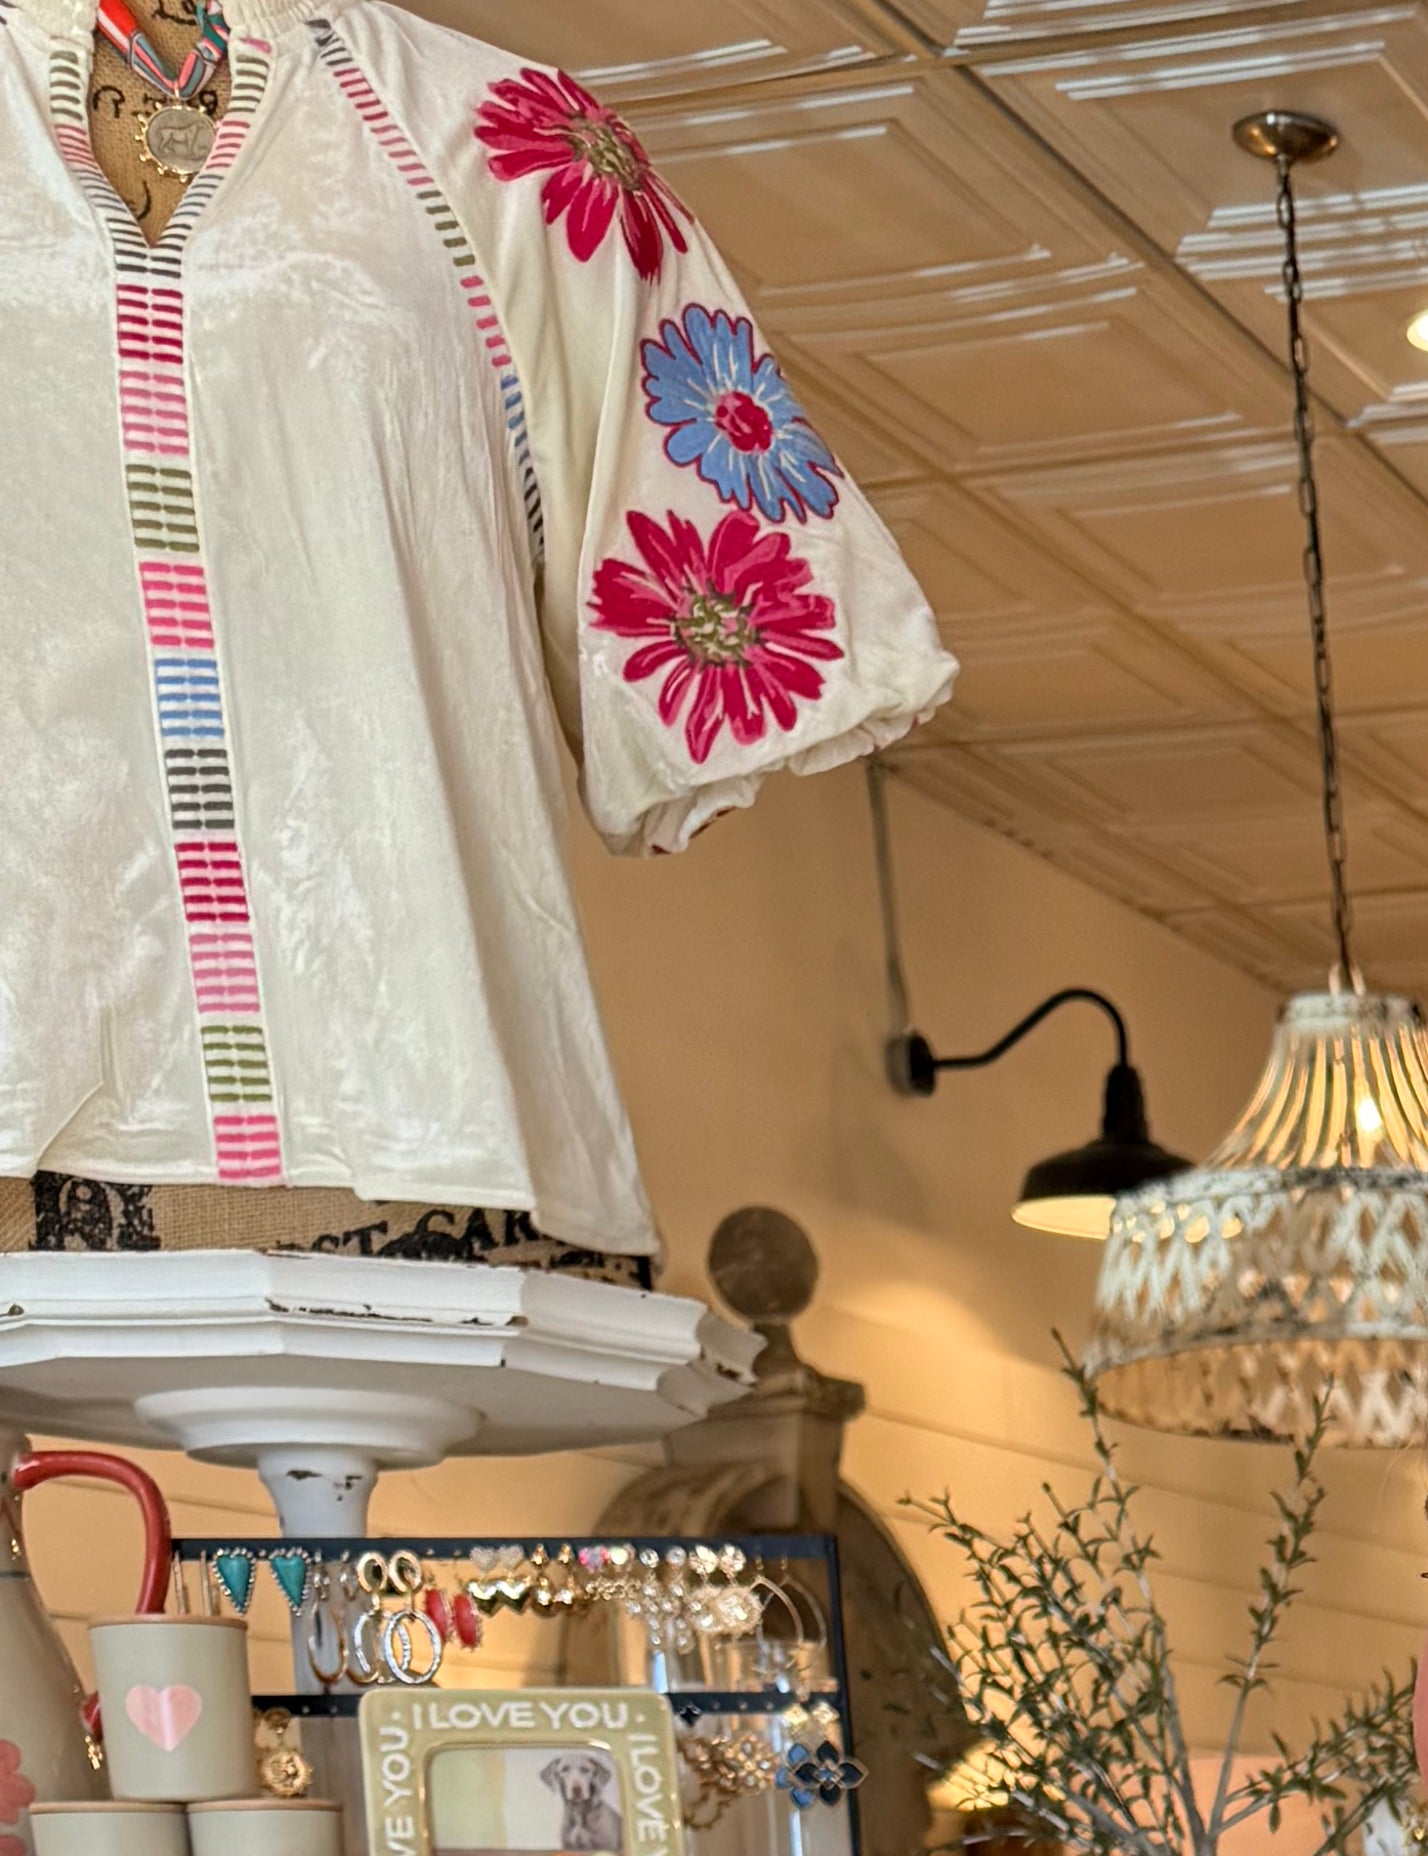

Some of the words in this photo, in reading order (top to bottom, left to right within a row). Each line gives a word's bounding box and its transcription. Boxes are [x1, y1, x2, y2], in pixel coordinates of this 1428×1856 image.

[413, 1703, 422, 1729] I
[428, 1702, 536, 1729] LOVE
[539, 1702, 629, 1729] YOU
[627, 1732, 657, 1742] I
[379, 1725, 414, 1808] YOU
[629, 1747, 668, 1843] LOVE
